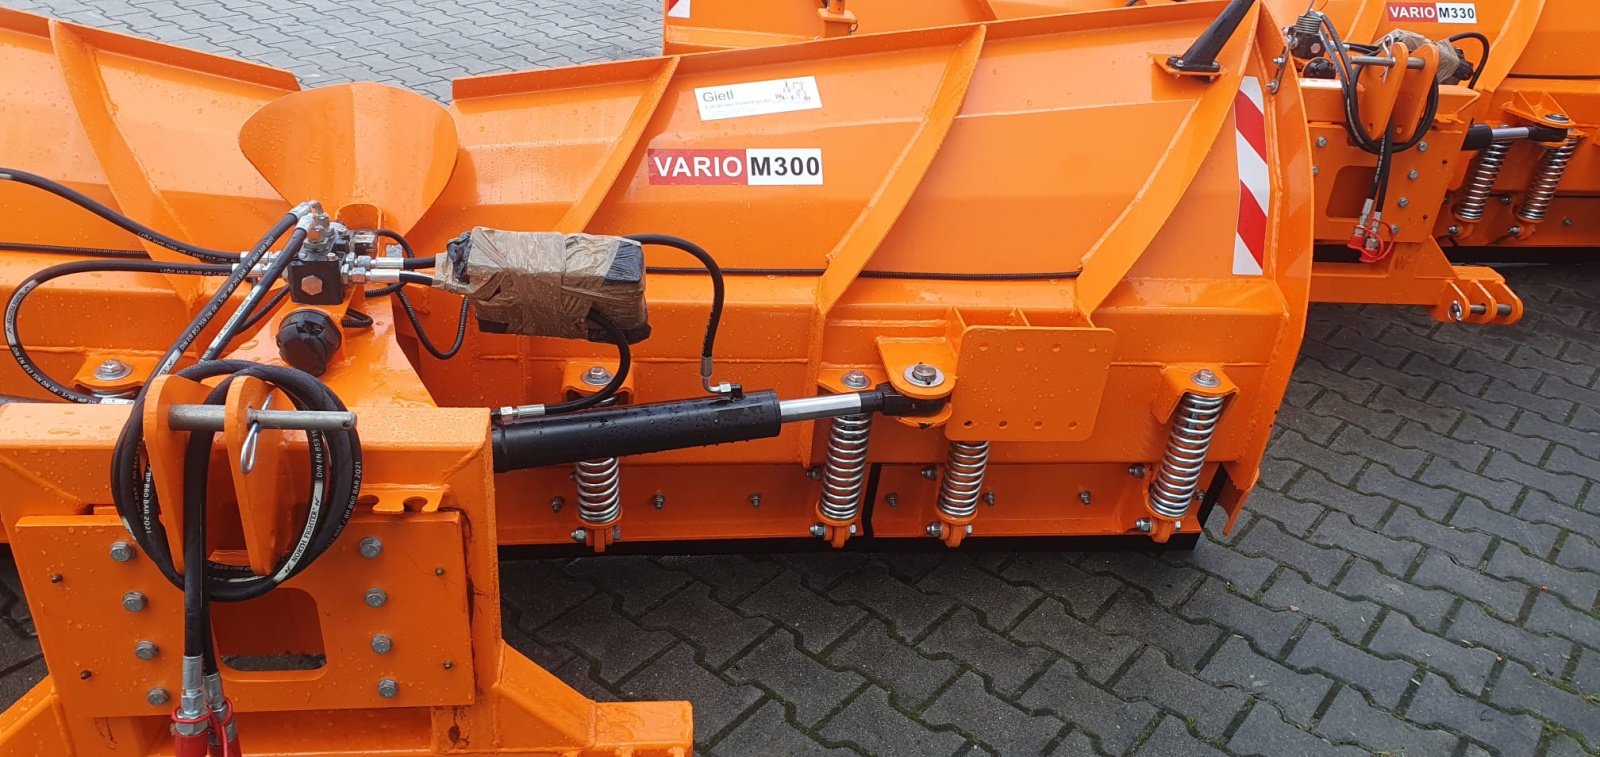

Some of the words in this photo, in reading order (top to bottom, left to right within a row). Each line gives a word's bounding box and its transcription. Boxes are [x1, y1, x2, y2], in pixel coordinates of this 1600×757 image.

[1389, 6, 1435, 18] VARIO
[1439, 8, 1474, 18] M330
[702, 90, 734, 102] Gietl
[653, 156, 743, 177] VARIO
[751, 156, 820, 176] M300
[180, 341, 188, 350] DIN
[12, 346, 20, 357] DIN
[18, 356, 25, 365] EN
[23, 364, 33, 374] 853
[41, 380, 50, 388] DN
[315, 453, 322, 464] EN
[292, 536, 308, 563] NORTH
